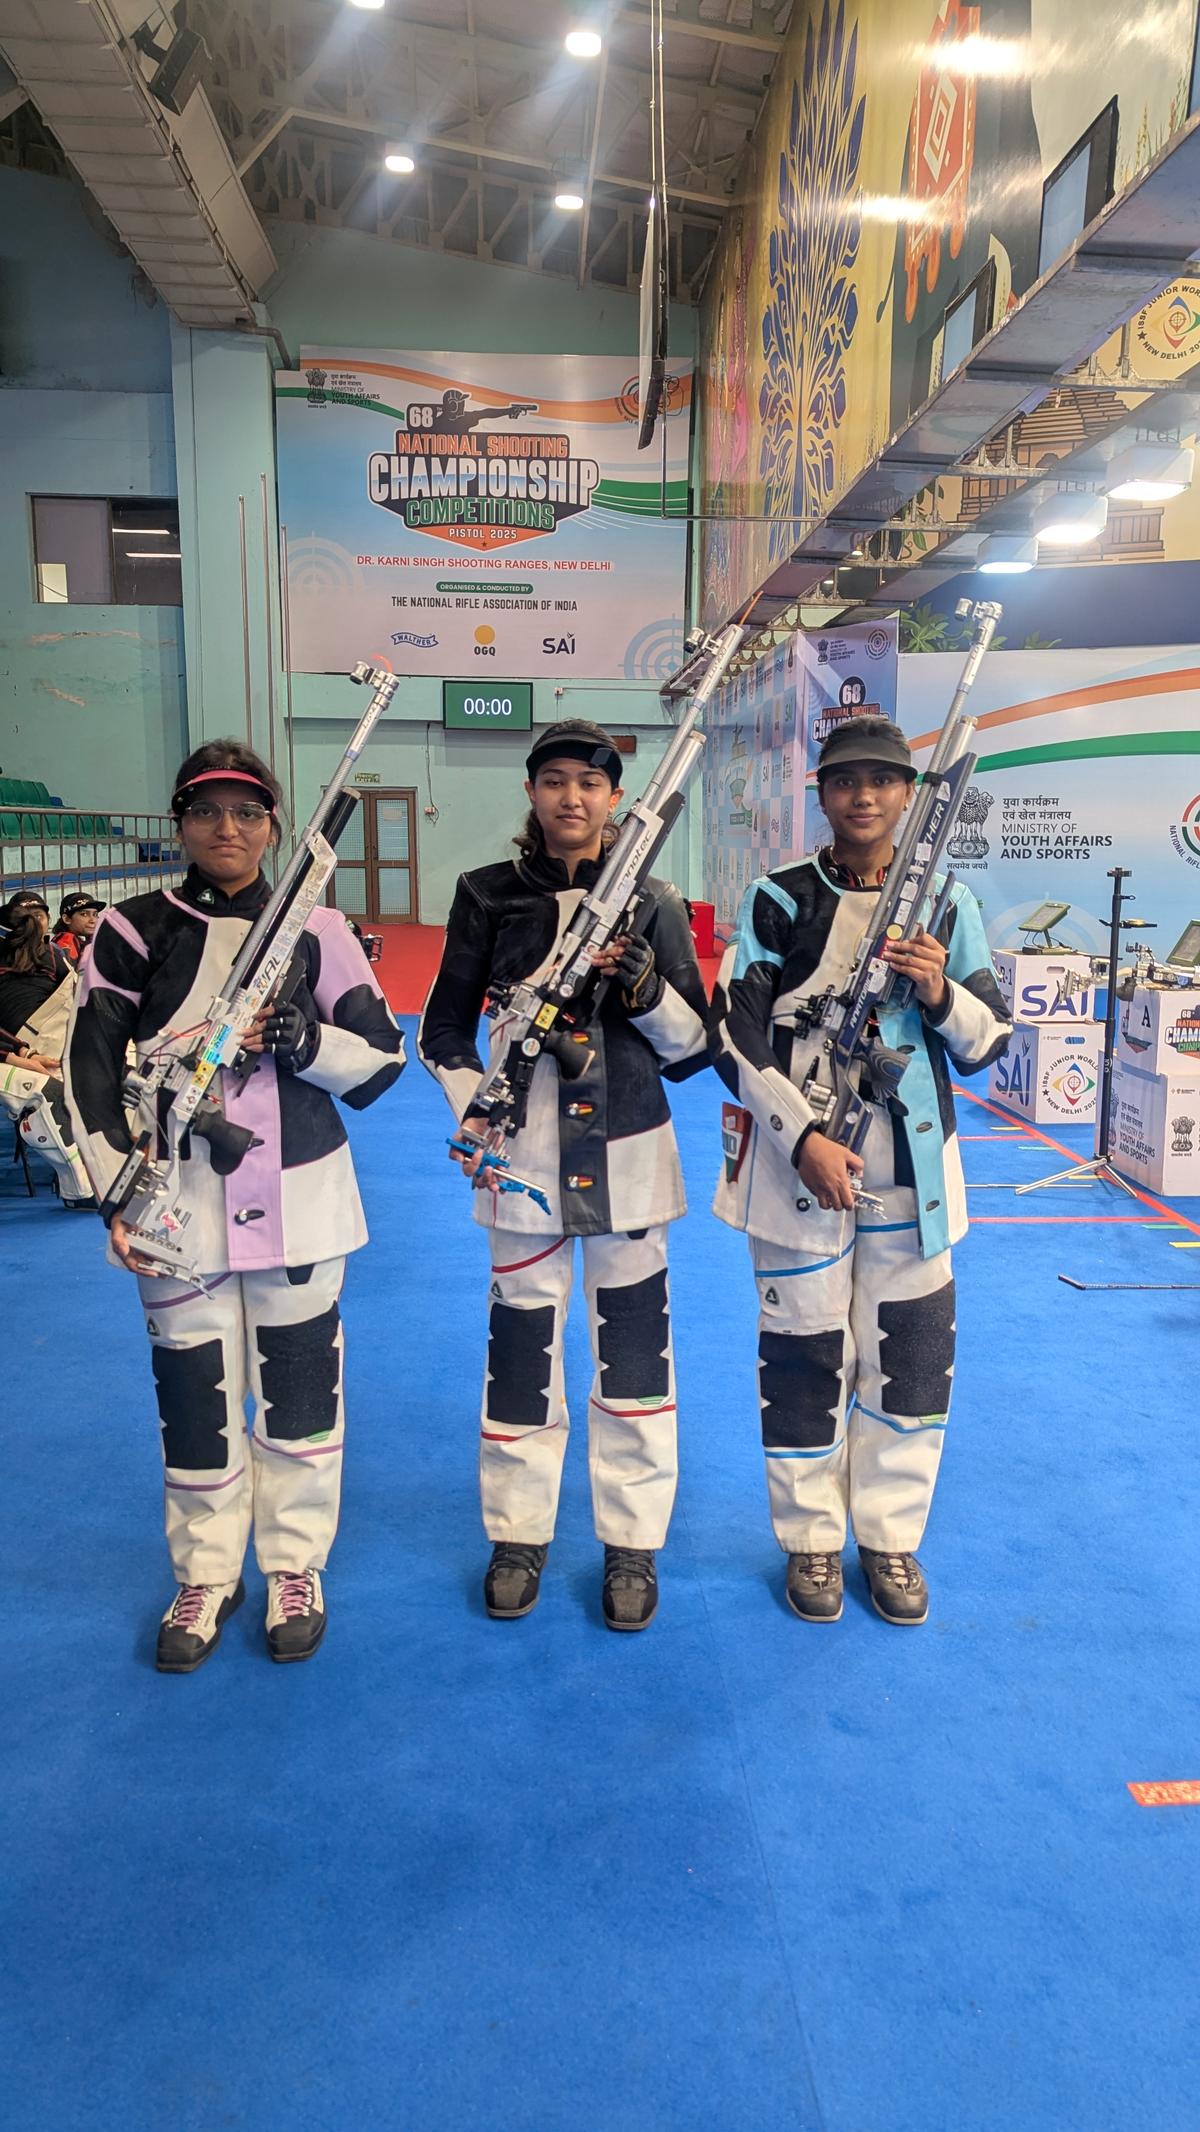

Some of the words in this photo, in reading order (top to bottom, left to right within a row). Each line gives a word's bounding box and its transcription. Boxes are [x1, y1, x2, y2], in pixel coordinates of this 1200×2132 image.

[1137, 309, 1148, 330] ISSF
[1147, 286, 1179, 308] JUNIOR
[1181, 285, 1200, 298] WOR
[1142, 341, 1160, 356] NEW
[1160, 351, 1188, 360] DELHI
[409, 406, 434, 428] 68
[399, 433, 482, 456] NATIONAL
[487, 436, 568, 458] SHOOTING
[370, 455, 599, 506] CHAMPIONSHIP
[406, 500, 555, 529] COMPETITIONS
[449, 528, 485, 538] PISTOL
[490, 529, 517, 539] 2025
[357, 556, 375, 566] DR.
[377, 556, 410, 567] KARNI
[413, 557, 445, 568] SINGH
[448, 558, 502, 569] SHOOTING
[505, 560, 552, 571] RANGES,
[554, 561, 578, 570] NEW
[580, 561, 611, 571] DELHI
[440, 583, 475, 591] ORGANISED
[392, 596, 408, 607] THE
[410, 597, 453, 609] NATIONAL
[455, 598, 479, 609] RIFLE
[483, 599, 538, 611] ASSOCIATION
[541, 600, 552, 610] OF
[554, 600, 578, 611] INDIA
[397, 635, 432, 646] WALTHER
[542, 638, 576, 654] SAI
[474, 646, 496, 656] OGQ
[842, 684, 861, 705] 68
[463, 697, 512, 716] 00:00
[1003, 797, 1022, 808] युवा
[1022, 795, 1059, 807] कार्यक्रम
[1002, 810, 1016, 820] एवं
[1018, 809, 1036, 820] खेल
[1039, 810, 1072, 820] मंत्रालय
[1002, 823, 1059, 834] MINISTRY
[1061, 823, 1077, 834] OF
[1001, 836, 1050, 846] YOUTH
[1055, 836, 1113, 847] AFFAIRS
[1169, 825, 1186, 858] NATIONAL
[1185, 856, 1200, 869] RIFL
[1000, 849, 1032, 860] AND
[1036, 849, 1091, 860] SPORTS
[1020, 985, 1088, 1016] SAI
[1141, 1004, 1151, 1028] A
[1182, 1010, 1192, 1018] 68
[1177, 1019, 1200, 1027] NATION
[1166, 1027, 1200, 1044] CHAM
[1050, 1055, 1075, 1071] JUNIOR
[995, 1050, 1031, 1106] SAI
[1046, 1097, 1060, 1110] NEW
[1060, 1107, 1082, 1115] DELHI
[1120, 1131, 1136, 1147] YOUTH
[1136, 1140, 1155, 1158] AFFAIRS
[1119, 1142, 1129, 1154] AND
[1130, 1147, 1148, 1165] SPORTS
